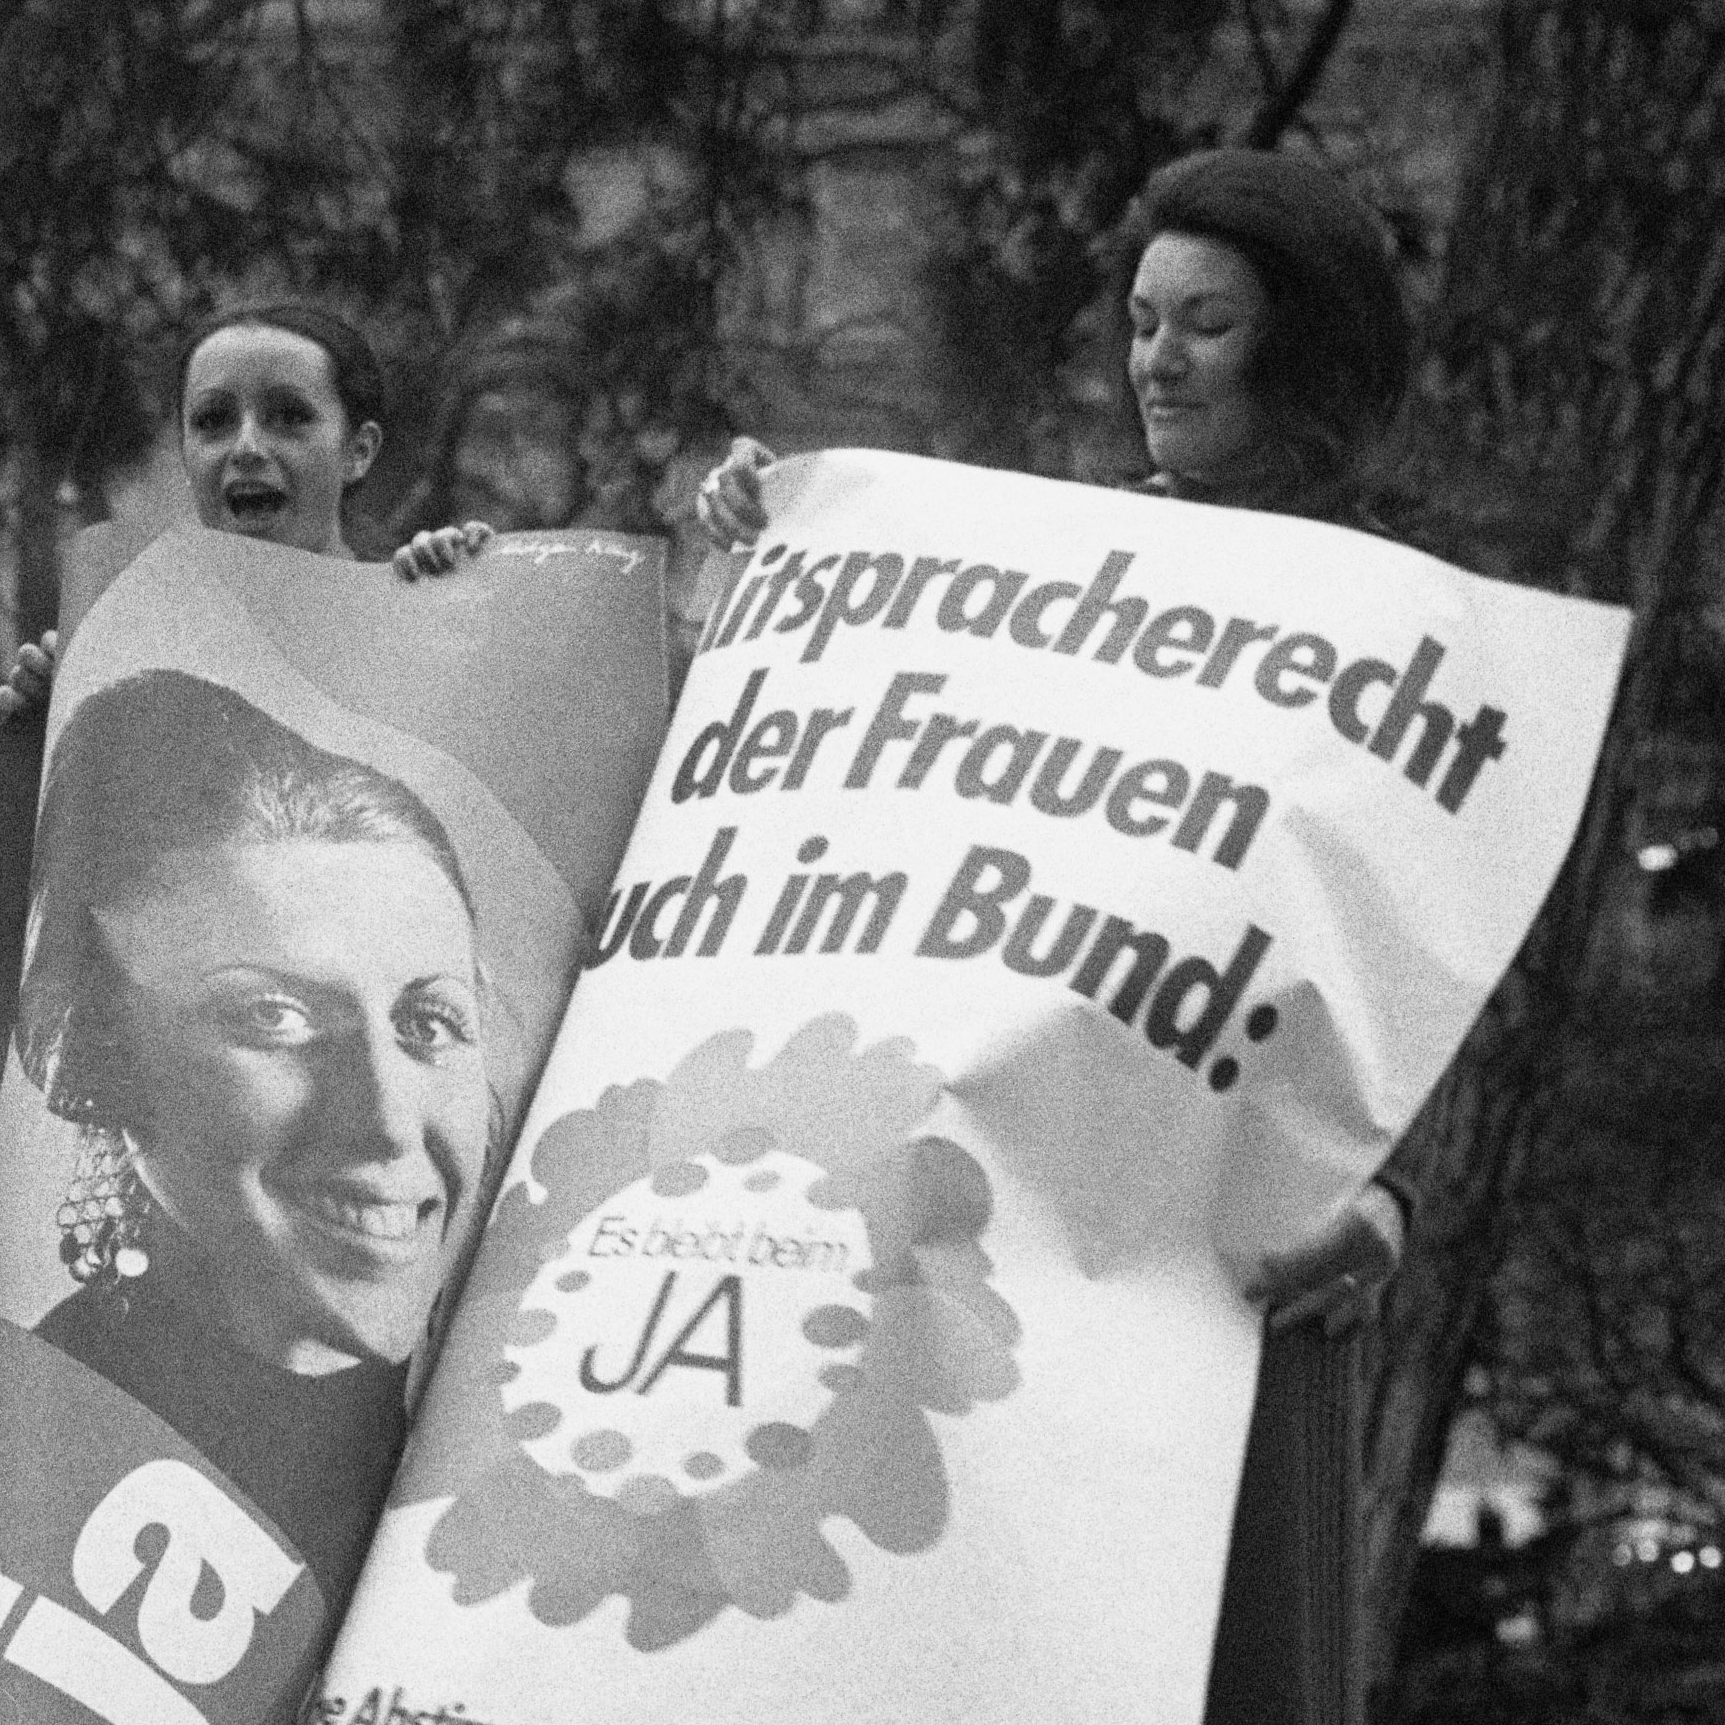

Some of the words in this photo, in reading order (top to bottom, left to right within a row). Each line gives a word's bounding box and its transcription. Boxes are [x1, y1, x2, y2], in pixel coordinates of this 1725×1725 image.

[671, 667, 855, 805] der
[843, 671, 1271, 872] Frauen
[700, 542, 1506, 816] itspracherecht
[581, 826, 749, 970] uch
[754, 835, 909, 957] im
[915, 843, 1278, 1094] Bund:
[578, 1270, 743, 1407] JA
